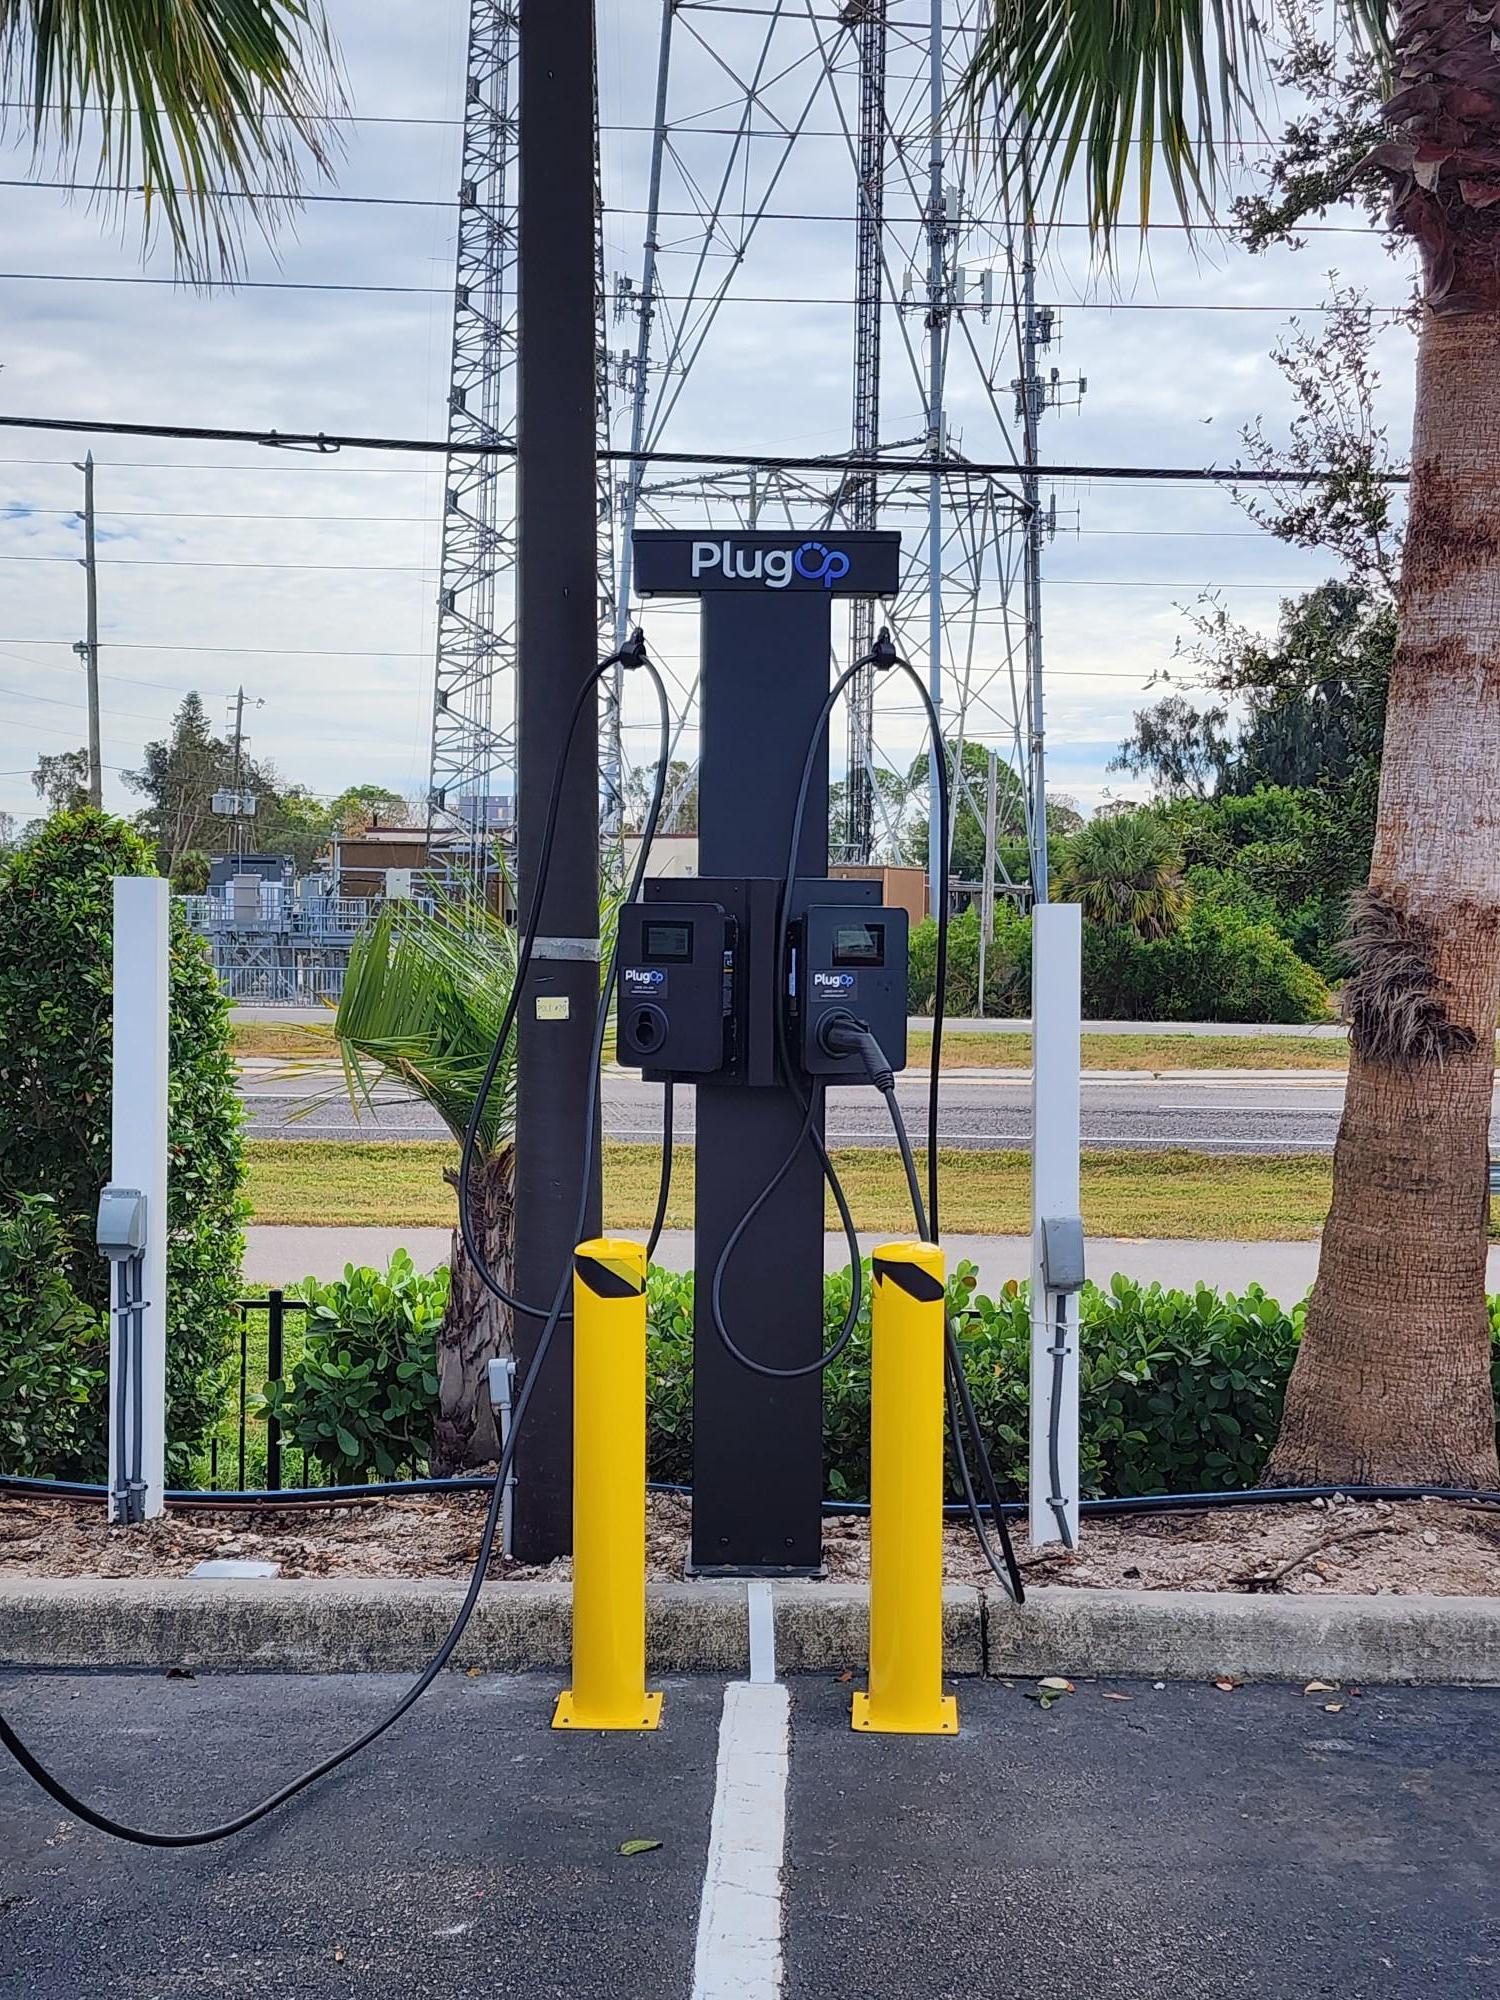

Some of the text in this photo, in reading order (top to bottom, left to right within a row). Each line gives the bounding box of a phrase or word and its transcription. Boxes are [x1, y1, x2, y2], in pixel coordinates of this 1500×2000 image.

[691, 540, 850, 588] PlugOp
[625, 969, 664, 984] PlugOp
[814, 973, 854, 988] PlugOp
